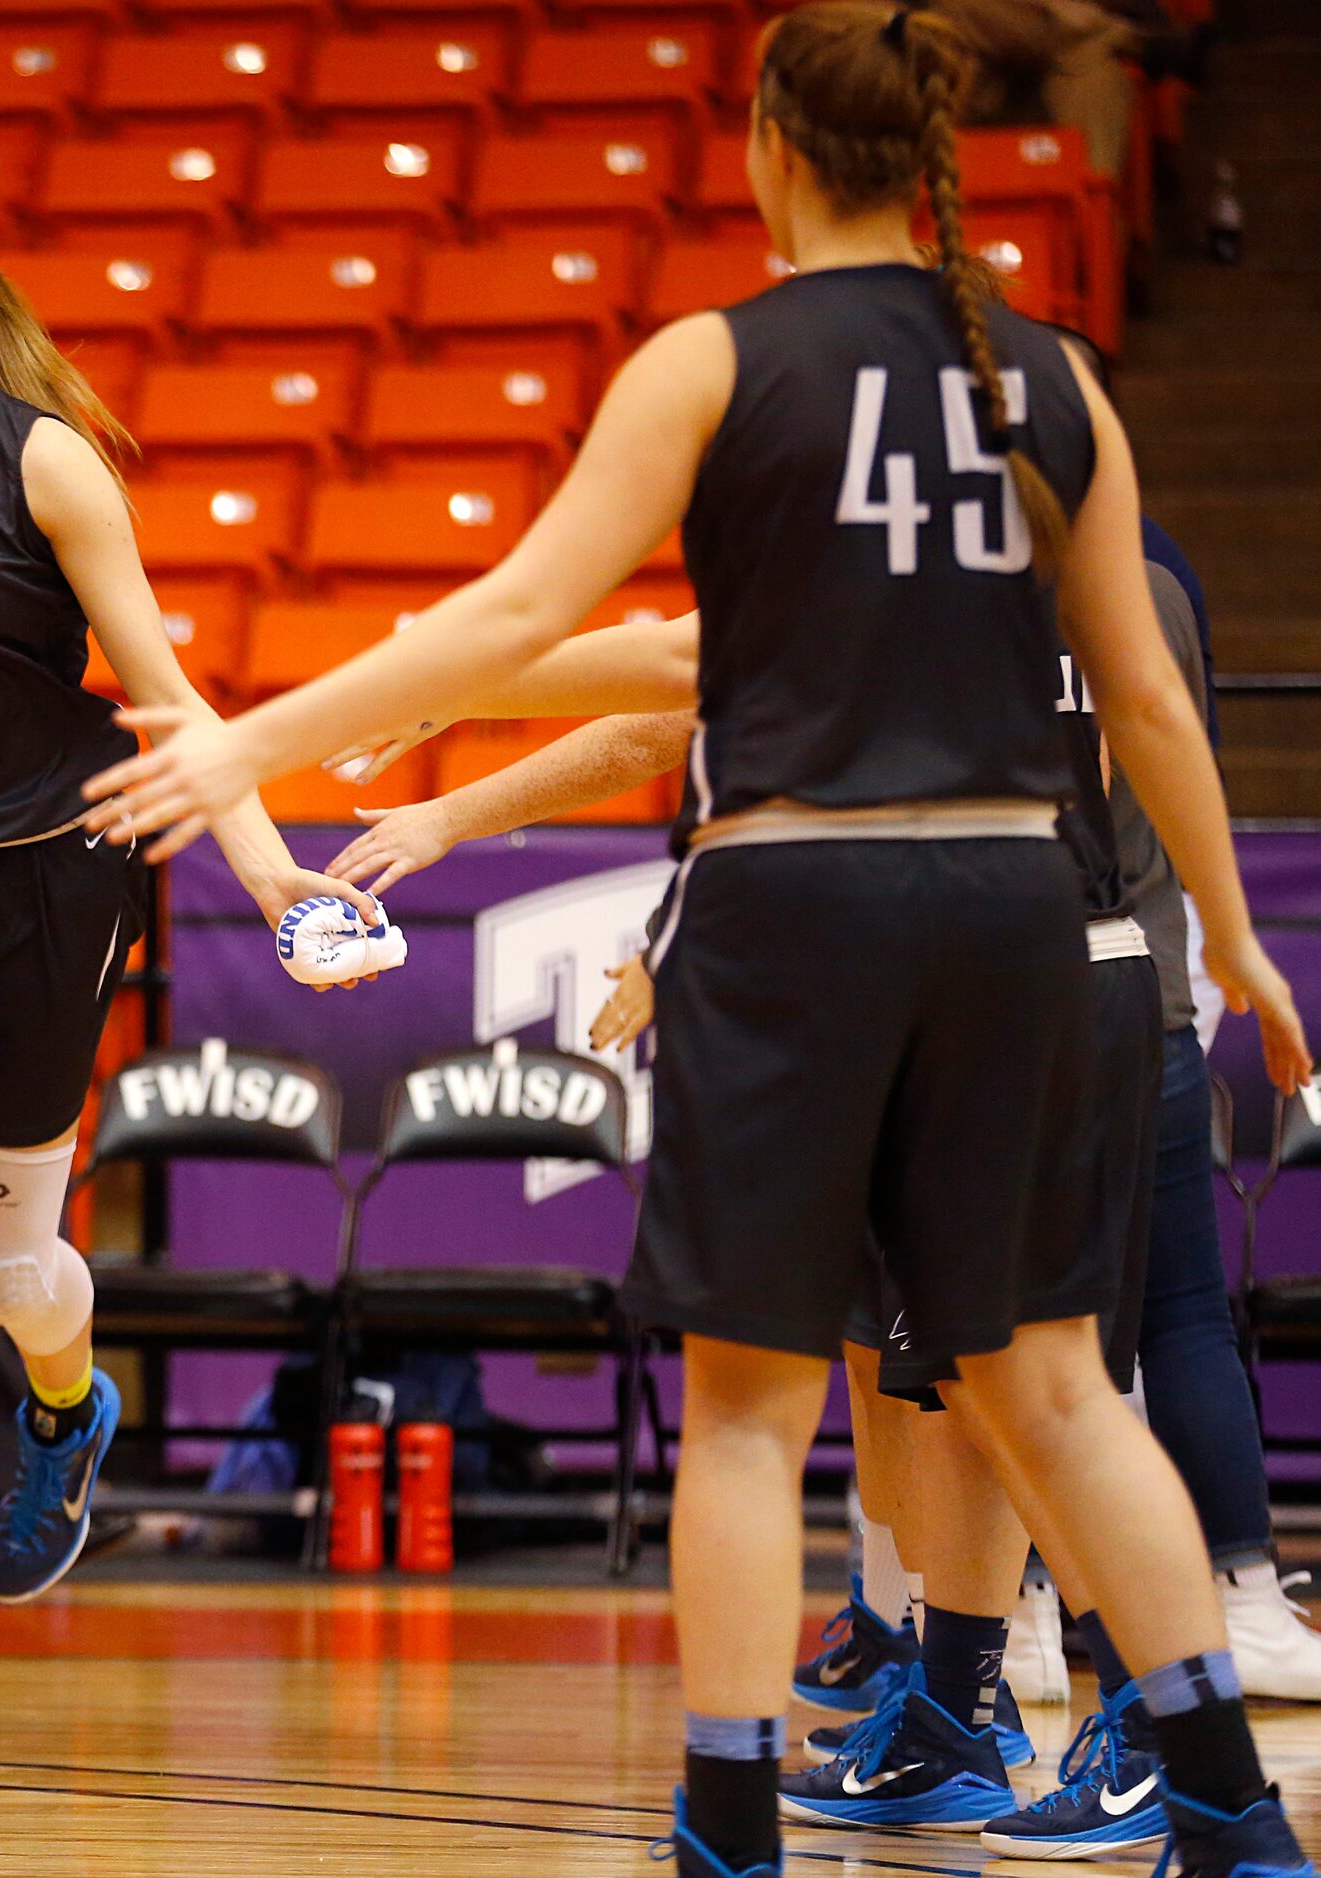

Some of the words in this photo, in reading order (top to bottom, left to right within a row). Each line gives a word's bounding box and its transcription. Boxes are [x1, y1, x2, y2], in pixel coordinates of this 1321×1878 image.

[836, 366, 1032, 576] 45
[118, 1064, 320, 1129] FWISD
[405, 1064, 608, 1127] FWISD
